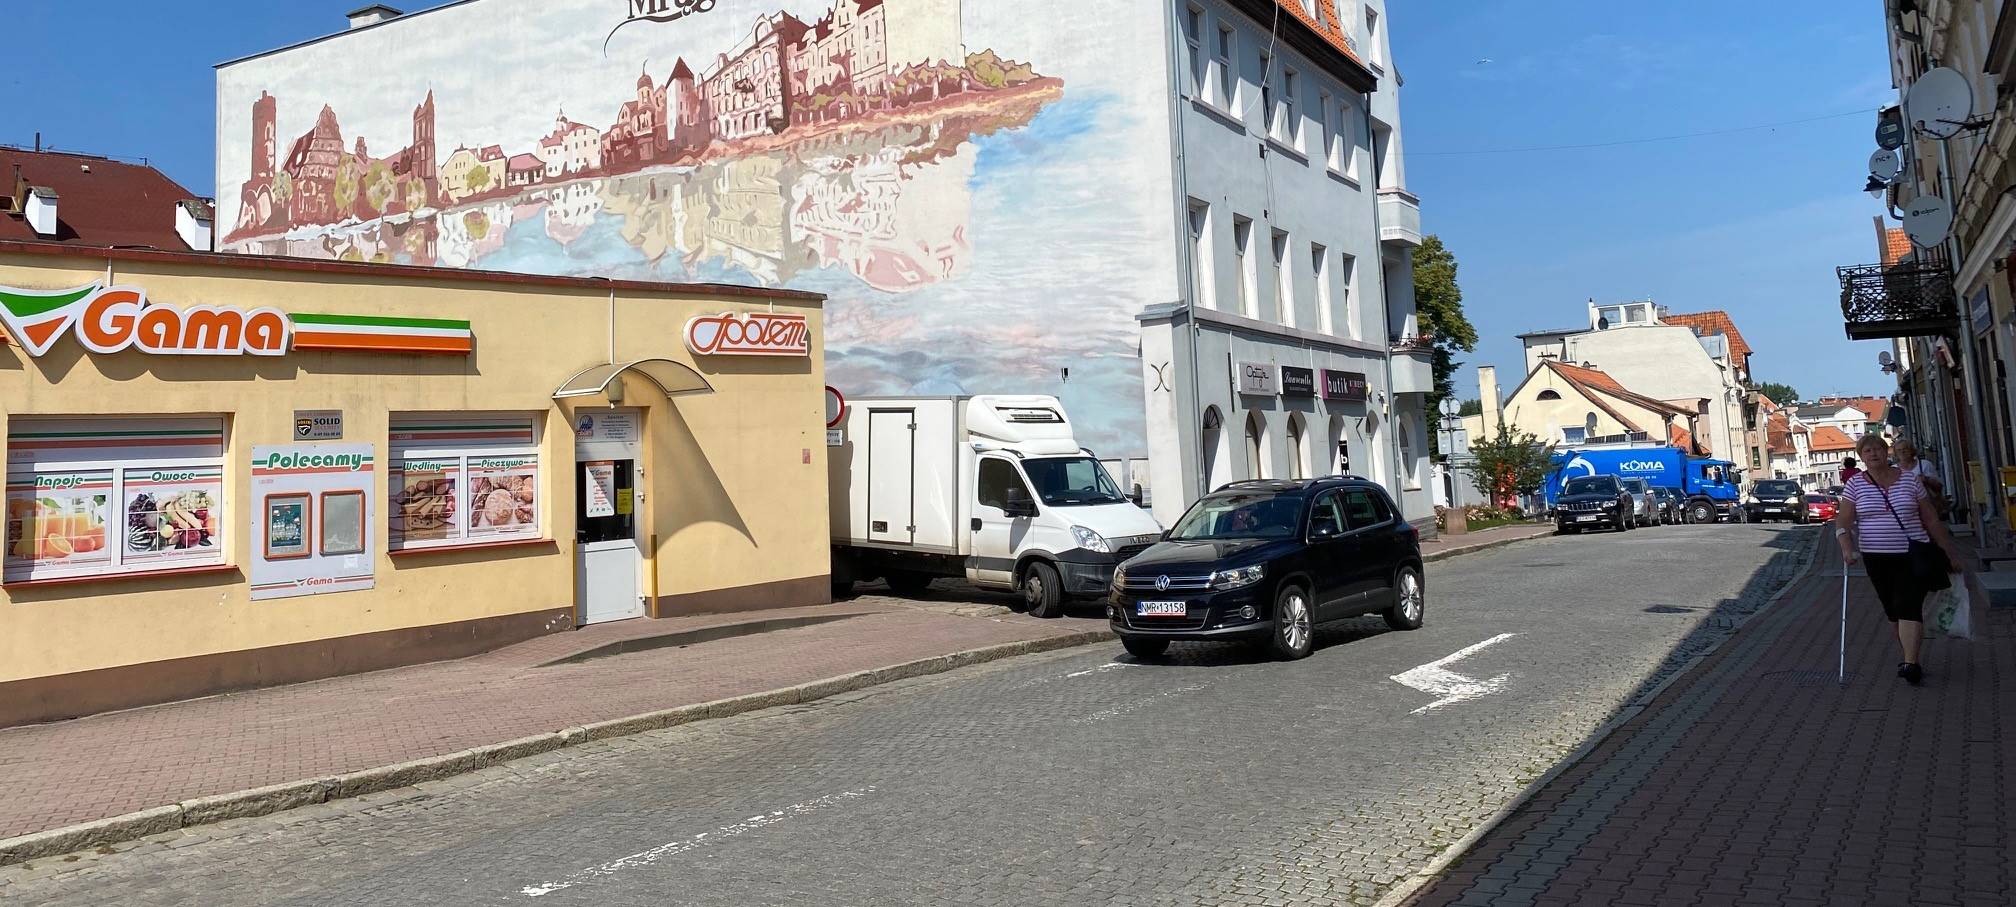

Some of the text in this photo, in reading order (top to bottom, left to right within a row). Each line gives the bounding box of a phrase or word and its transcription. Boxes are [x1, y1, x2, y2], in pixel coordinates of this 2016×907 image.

[83, 290, 283, 350] Gama
[1327, 375, 1348, 394] butik
[314, 417, 340, 425] SOLID
[268, 452, 362, 470] Polecamy
[481, 458, 525, 469] Pieczywo
[1619, 459, 1665, 471] KOMA
[34, 474, 84, 488] Napoje
[151, 471, 195, 482] Owoce
[1129, 536, 1151, 545] IVECO
[306, 577, 333, 586] Gama
[1159, 602, 1185, 613] 13158
